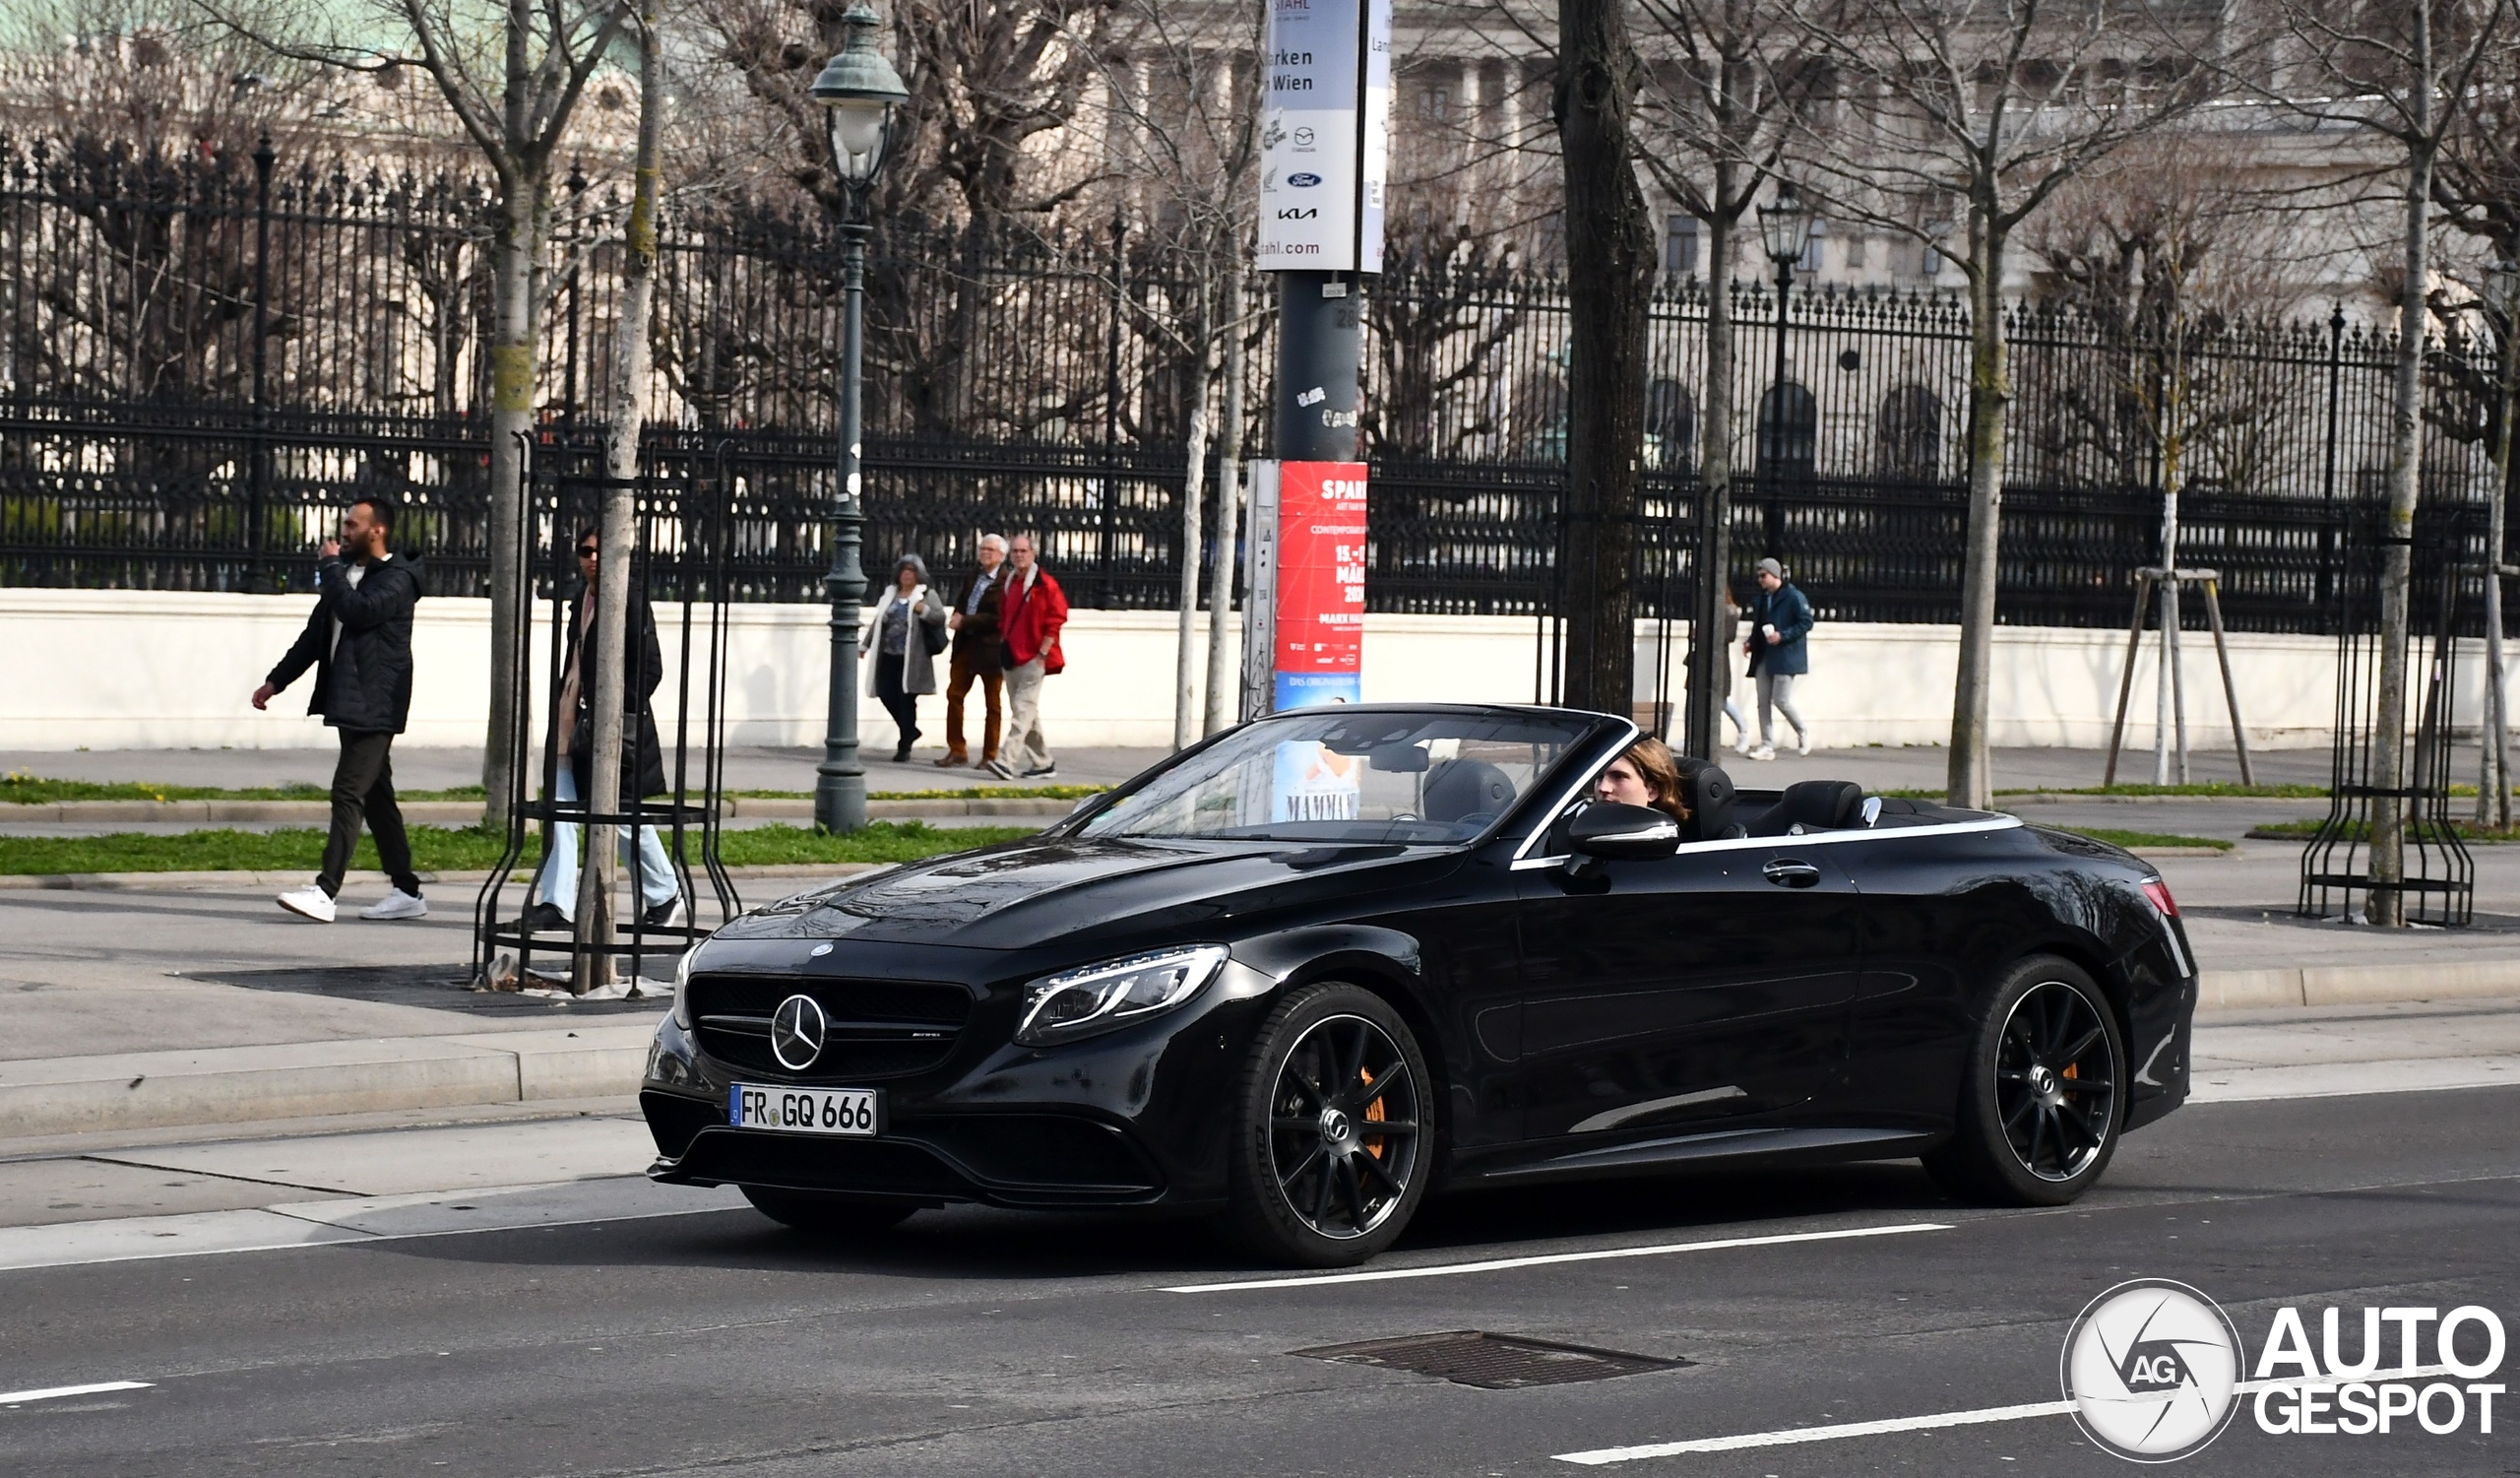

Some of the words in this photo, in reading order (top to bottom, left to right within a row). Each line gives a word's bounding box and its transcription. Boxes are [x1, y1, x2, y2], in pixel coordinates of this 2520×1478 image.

[1273, 75, 1312, 91] Wien
[1278, 208, 1317, 220] KIA
[741, 1091, 768, 1125] FR
[782, 1094, 815, 1127] GQ
[821, 1095, 872, 1129] 666
